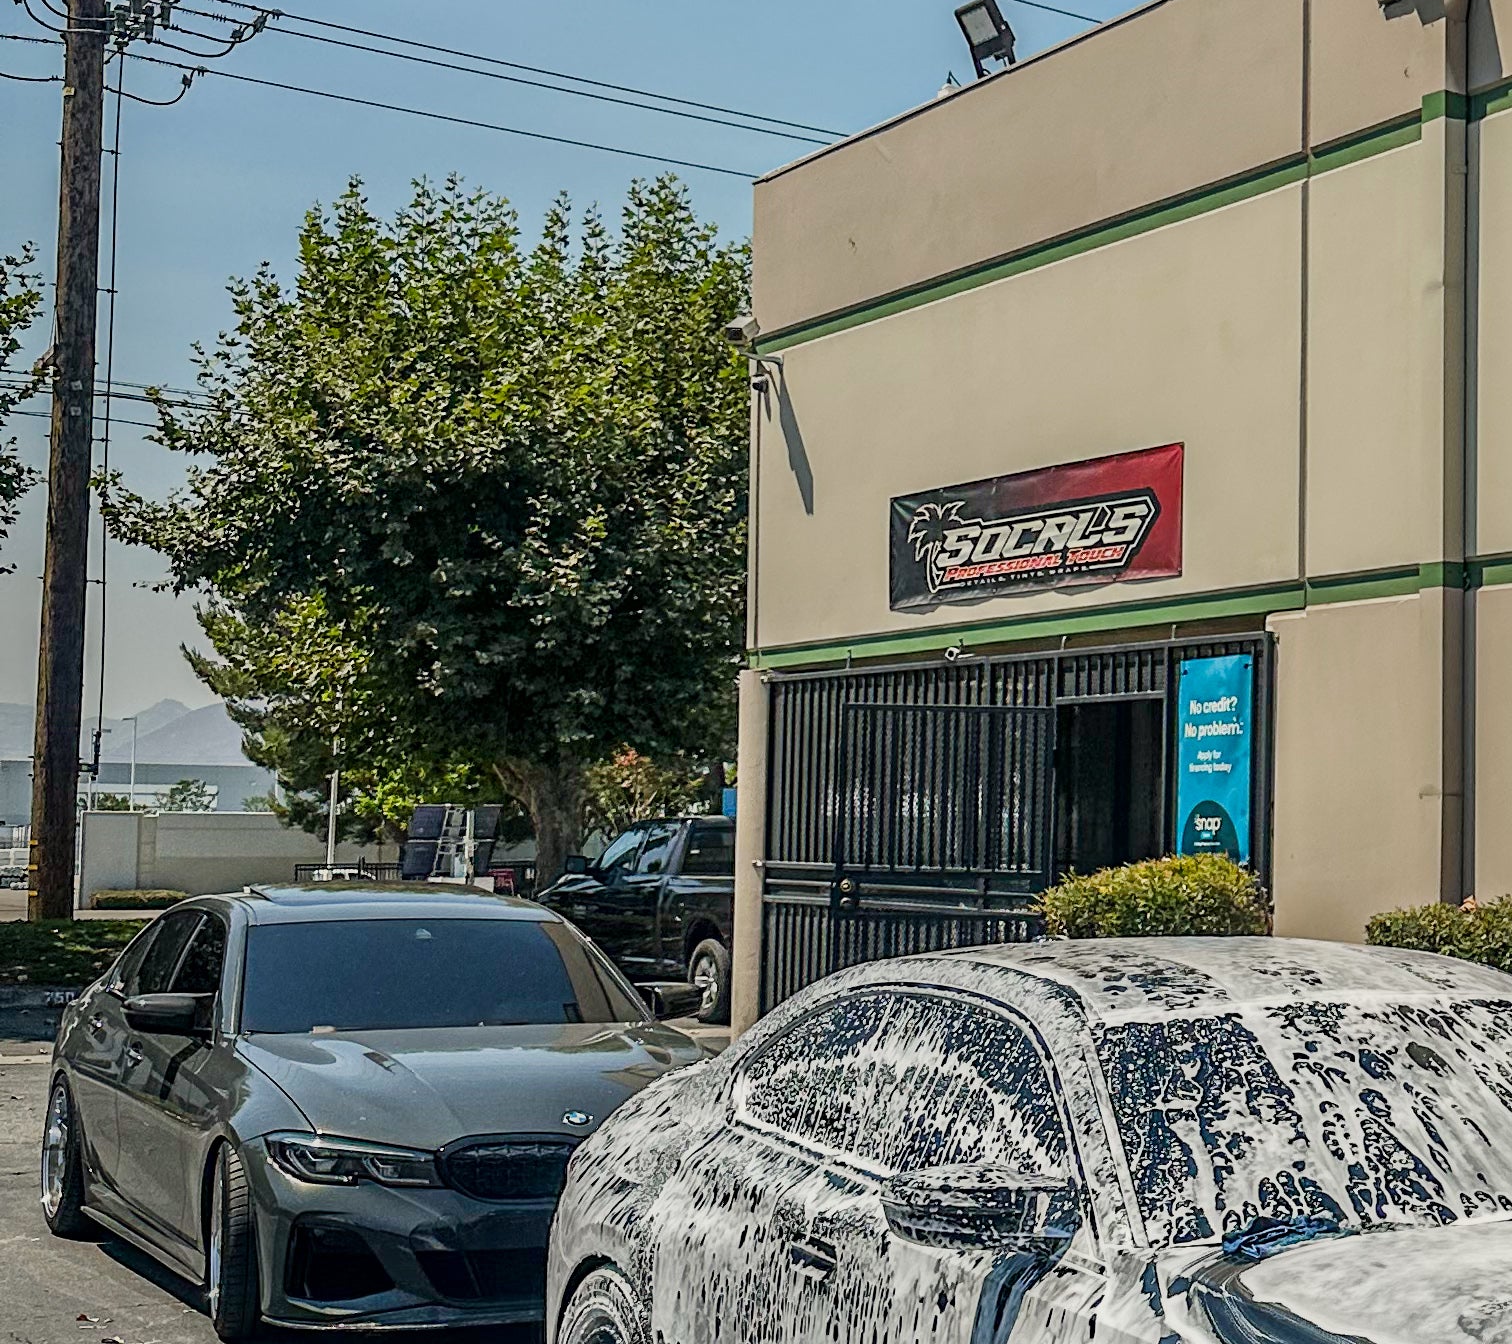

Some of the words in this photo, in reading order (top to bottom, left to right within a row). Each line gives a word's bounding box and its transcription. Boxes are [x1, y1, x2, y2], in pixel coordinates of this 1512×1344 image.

[1189, 699, 1202, 715] No
[1203, 695, 1238, 714] credit?
[1184, 722, 1198, 738] No
[1194, 816, 1222, 836] snap
